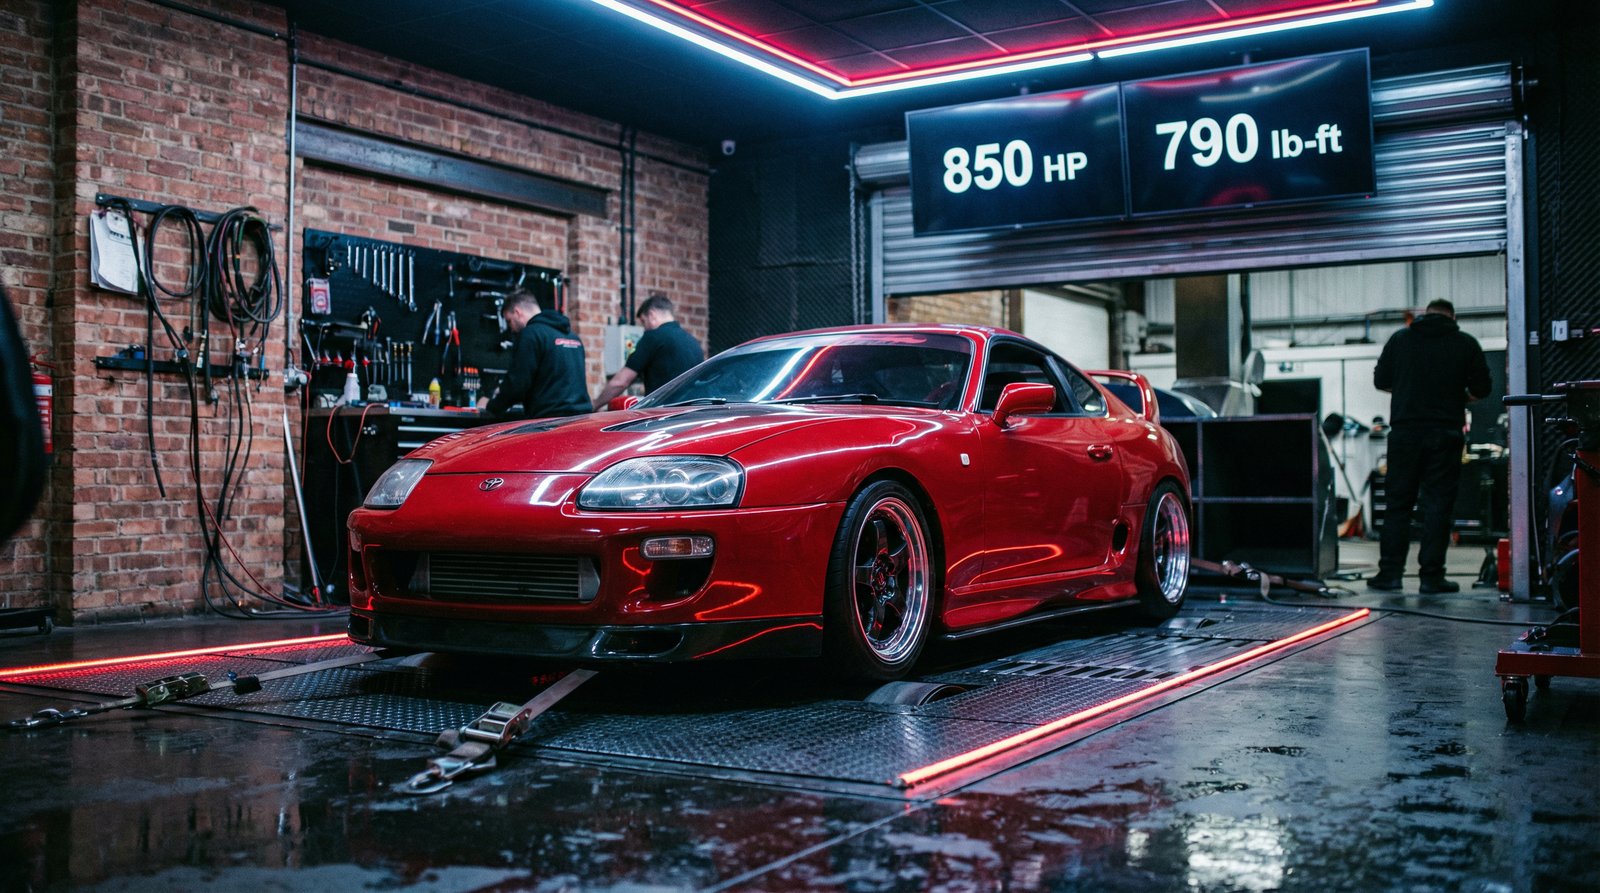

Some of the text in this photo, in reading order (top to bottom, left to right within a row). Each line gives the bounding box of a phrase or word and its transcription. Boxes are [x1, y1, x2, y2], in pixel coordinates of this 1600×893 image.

[943, 139, 1088, 194] 850 HP
[1155, 113, 1343, 170] 790 lb-ft
